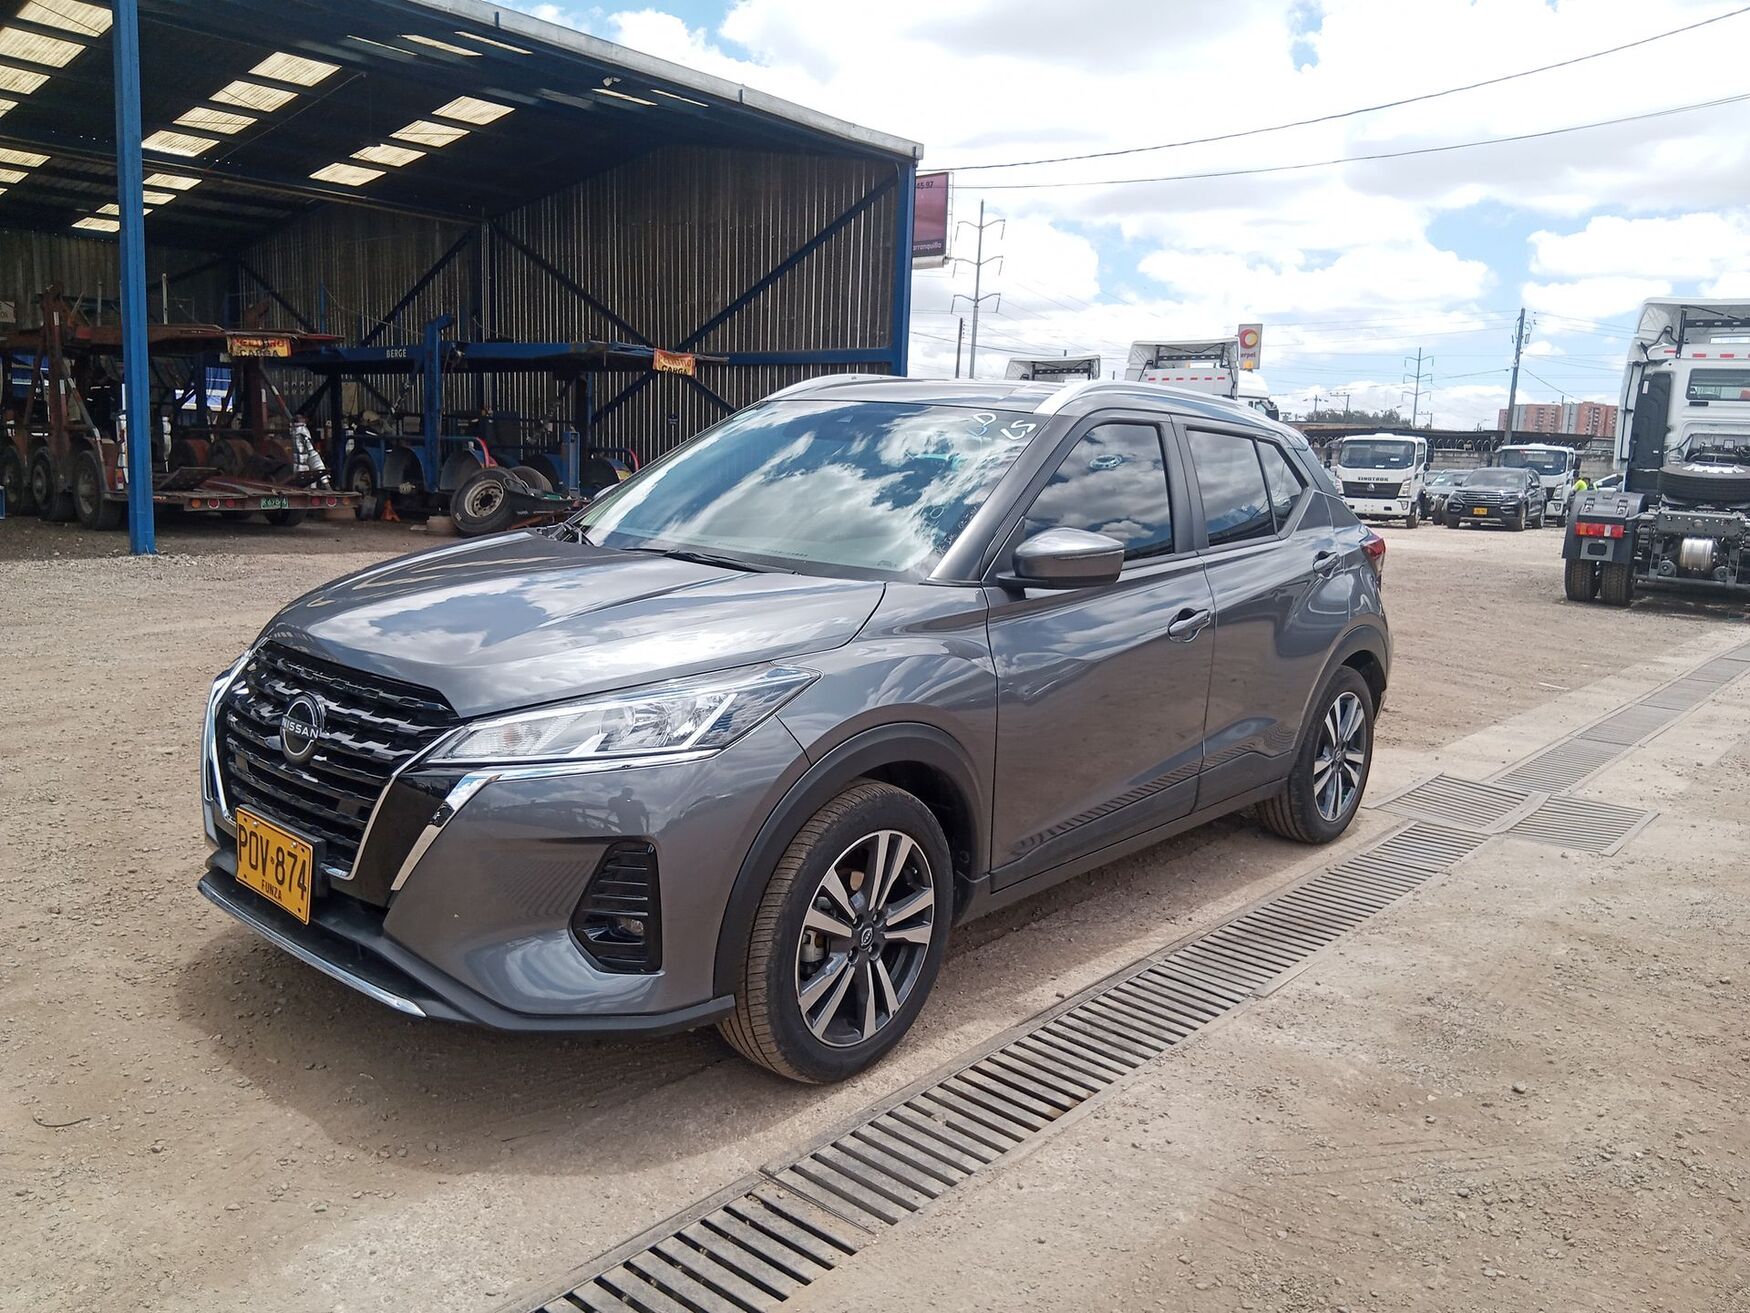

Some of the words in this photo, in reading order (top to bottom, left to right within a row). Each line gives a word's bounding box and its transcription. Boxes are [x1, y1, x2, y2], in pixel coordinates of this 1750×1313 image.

[386, 348, 407, 358] BERGE
[661, 364, 688, 375] CARGA
[282, 717, 319, 739] NISSAN
[261, 879, 283, 901] FUNZA
